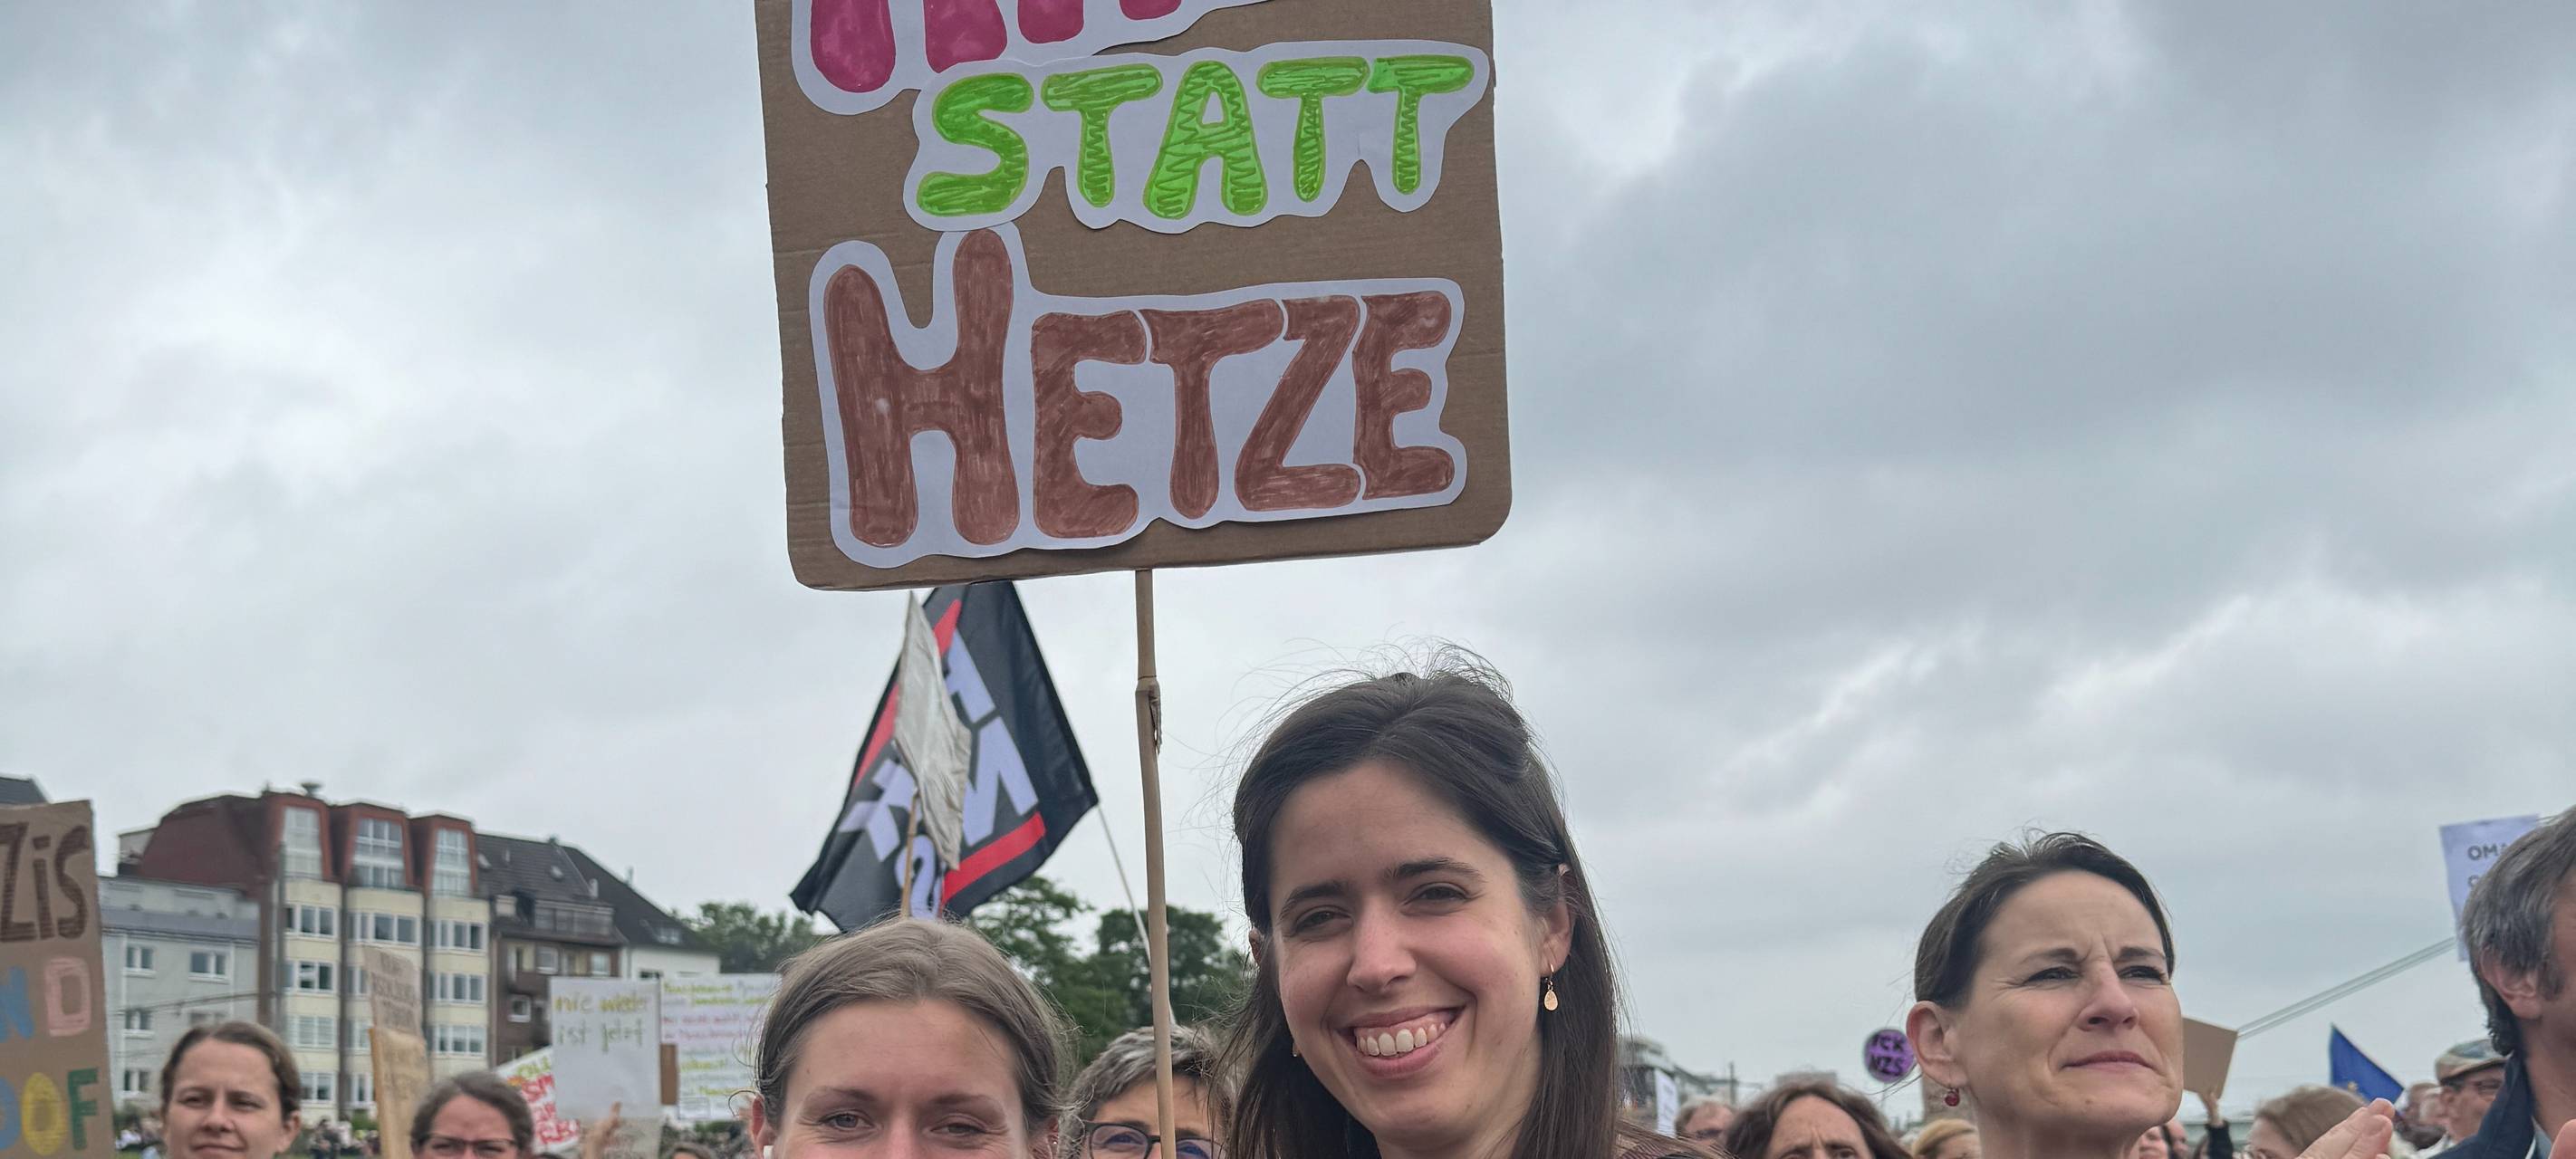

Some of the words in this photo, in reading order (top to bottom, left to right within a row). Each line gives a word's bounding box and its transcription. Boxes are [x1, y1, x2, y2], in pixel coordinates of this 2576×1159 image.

[916, 56, 1475, 219] STATT
[823, 228, 1456, 546] HETZE
[2467, 843, 2507, 861] OM
